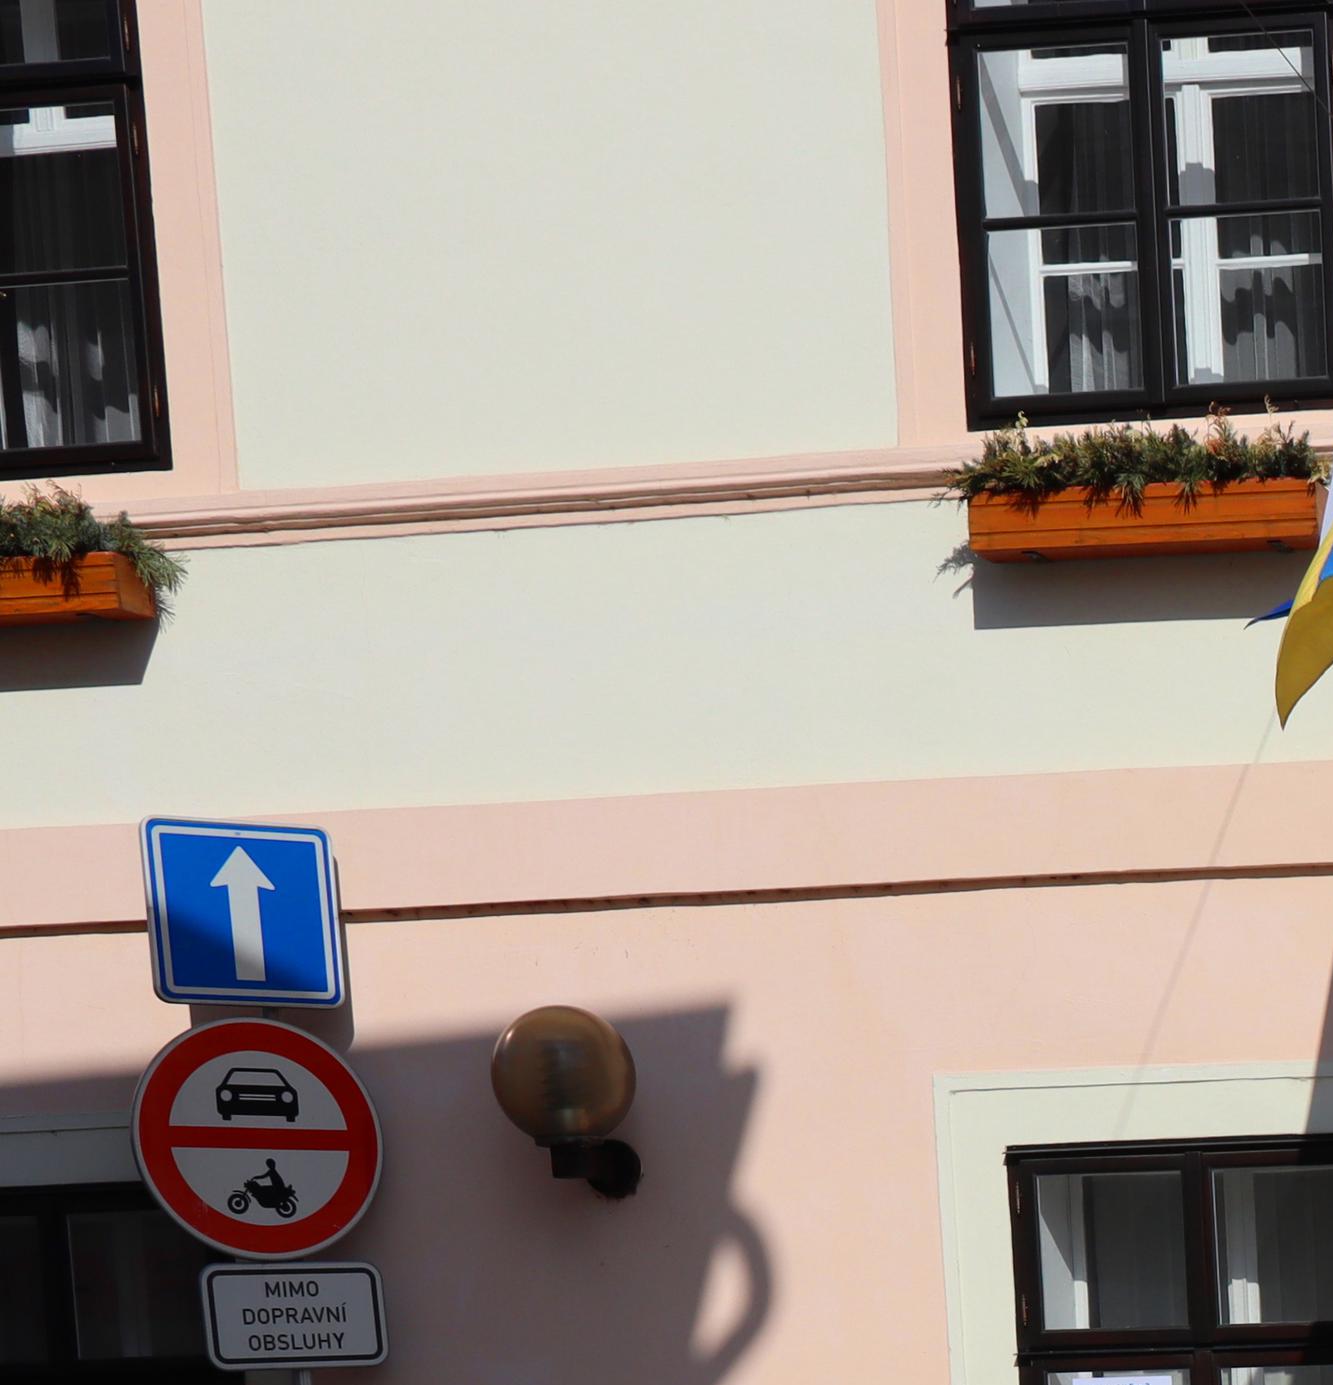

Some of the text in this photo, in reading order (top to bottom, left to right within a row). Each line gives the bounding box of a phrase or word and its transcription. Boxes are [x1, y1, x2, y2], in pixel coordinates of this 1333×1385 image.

[264, 1280, 319, 1298] MIMO
[242, 1302, 347, 1325] DOPRAVNÍ
[248, 1332, 344, 1351] OBSLUHY
